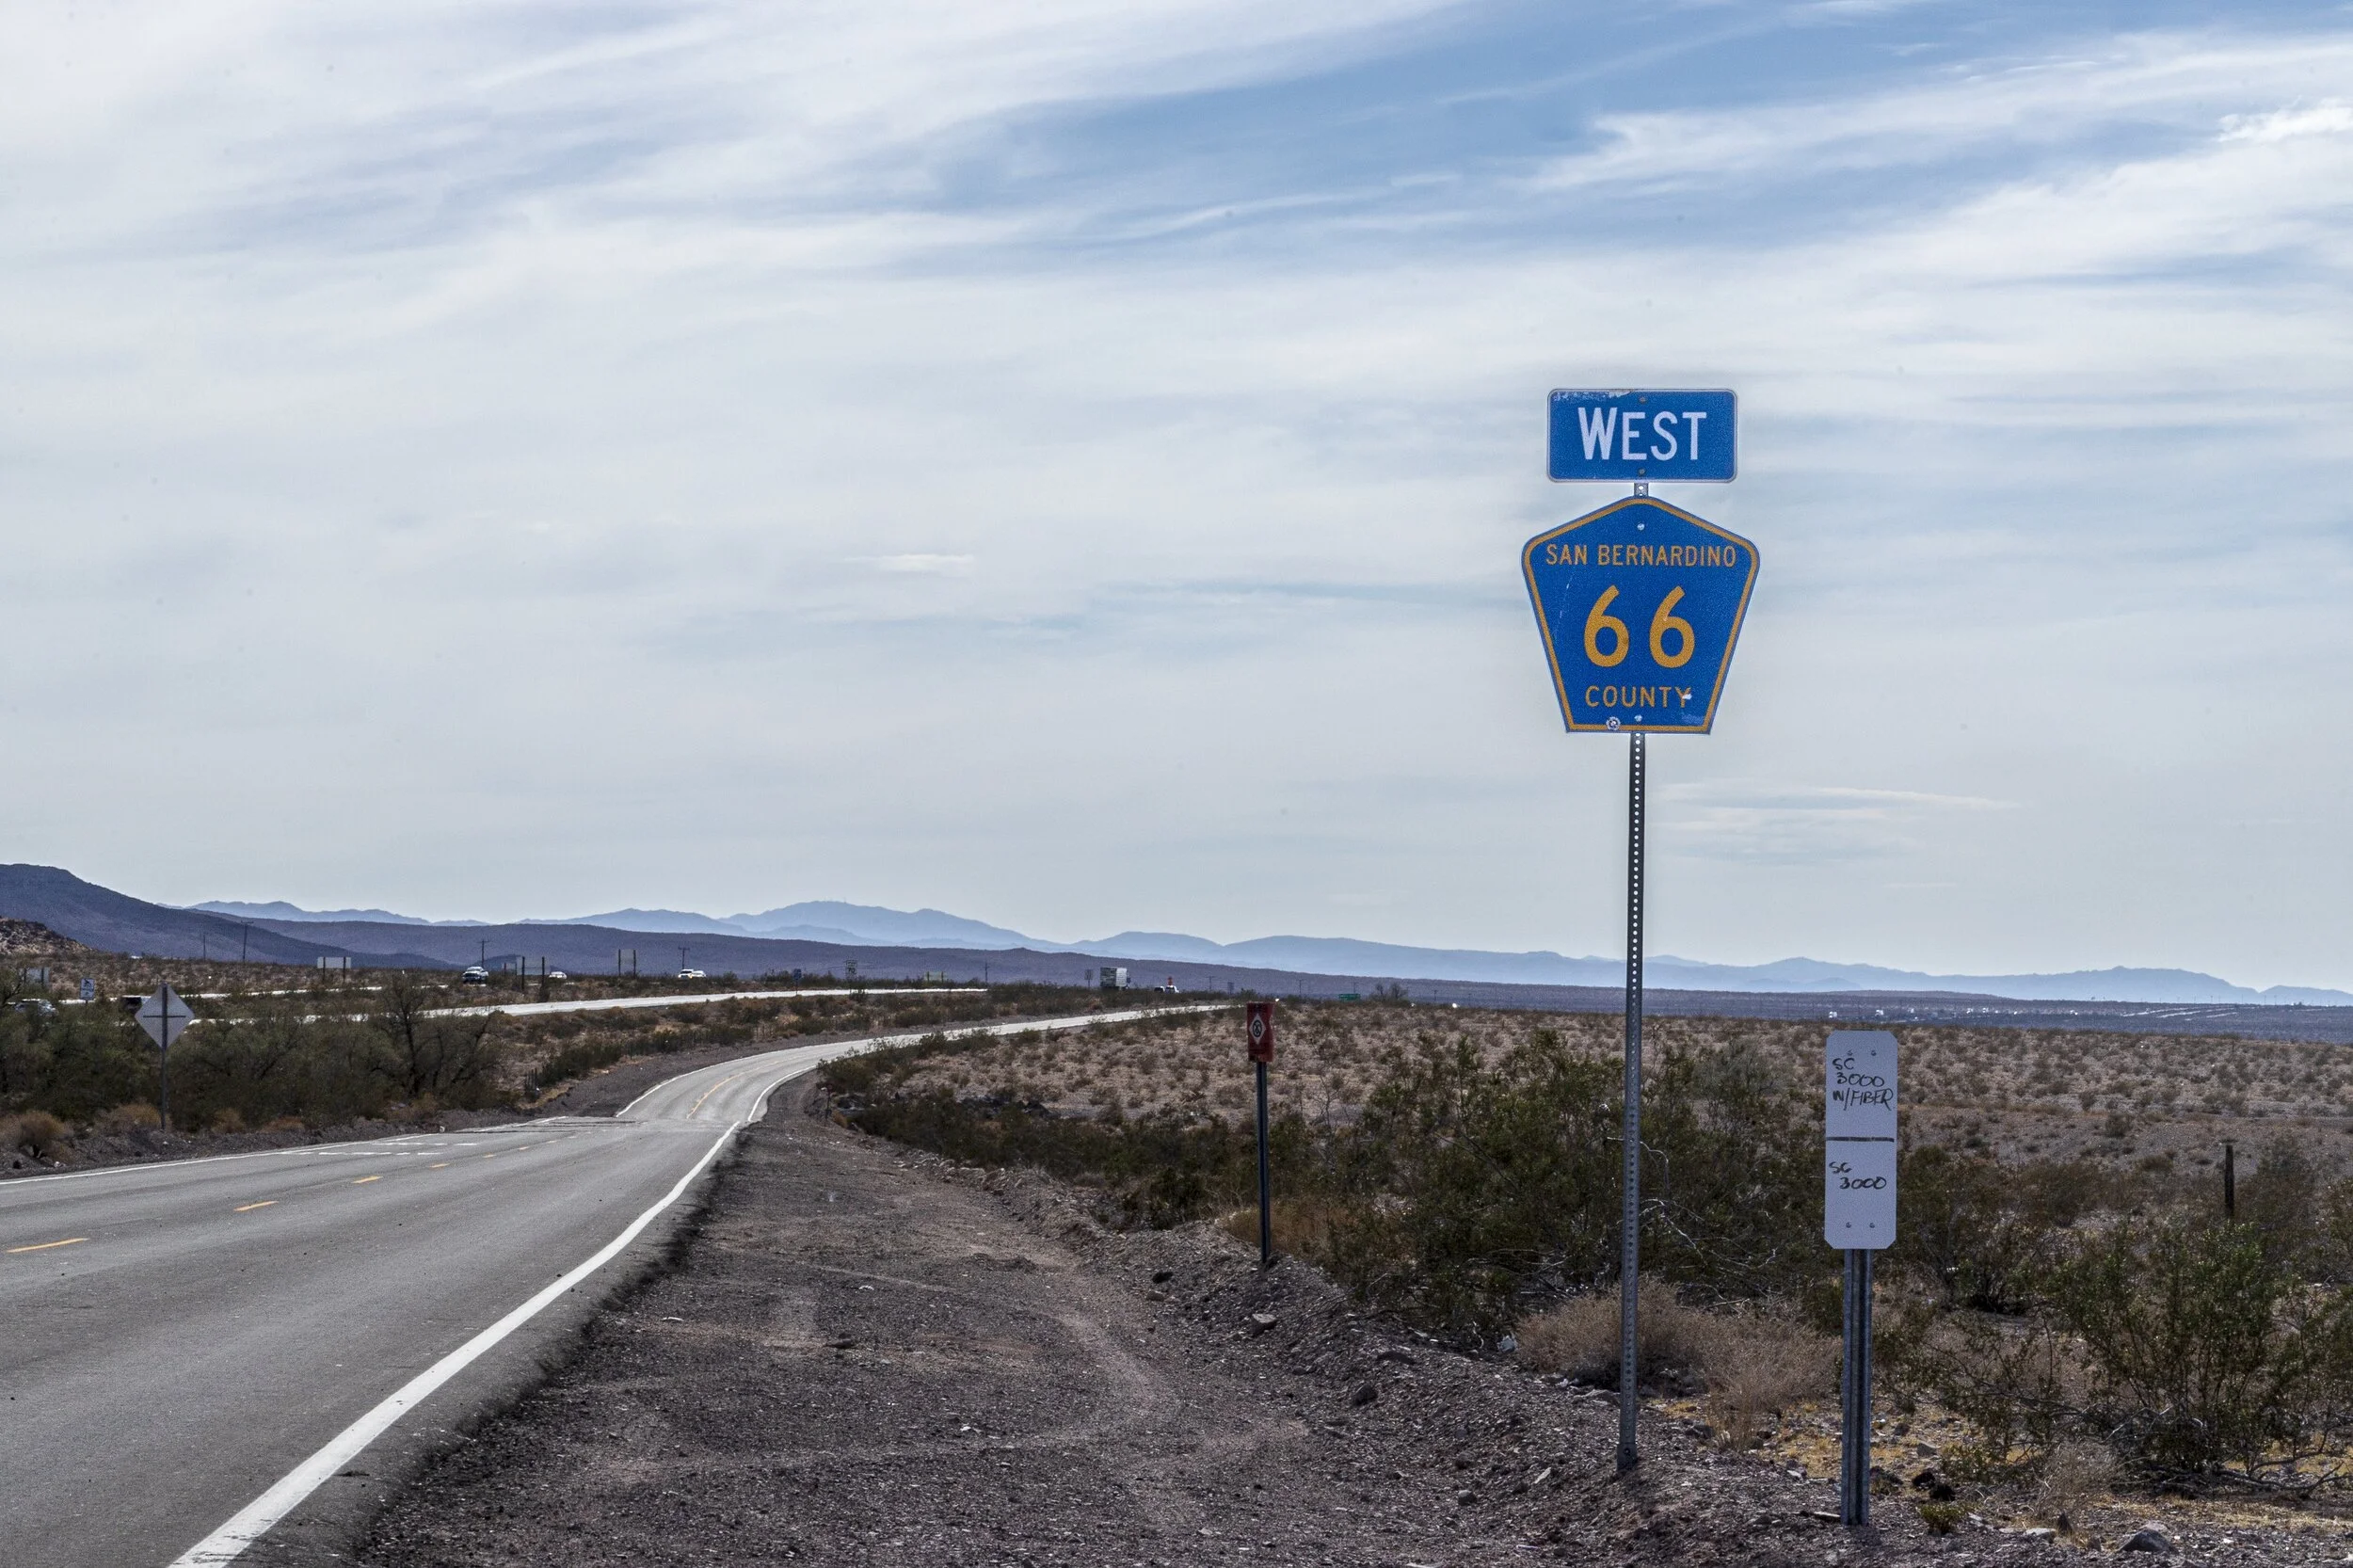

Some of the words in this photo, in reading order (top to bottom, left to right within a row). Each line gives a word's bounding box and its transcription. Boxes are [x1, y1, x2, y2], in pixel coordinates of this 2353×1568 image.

[1577, 407, 1707, 460] WEST
[1546, 543, 1589, 566] SAN
[1599, 544, 1737, 568] BERNARDINO
[1585, 685, 1692, 709] COUNTY
[1832, 1057, 1855, 1070] SC
[1836, 1071, 1885, 1087] 3000
[1839, 1176, 1887, 1190] 3000
